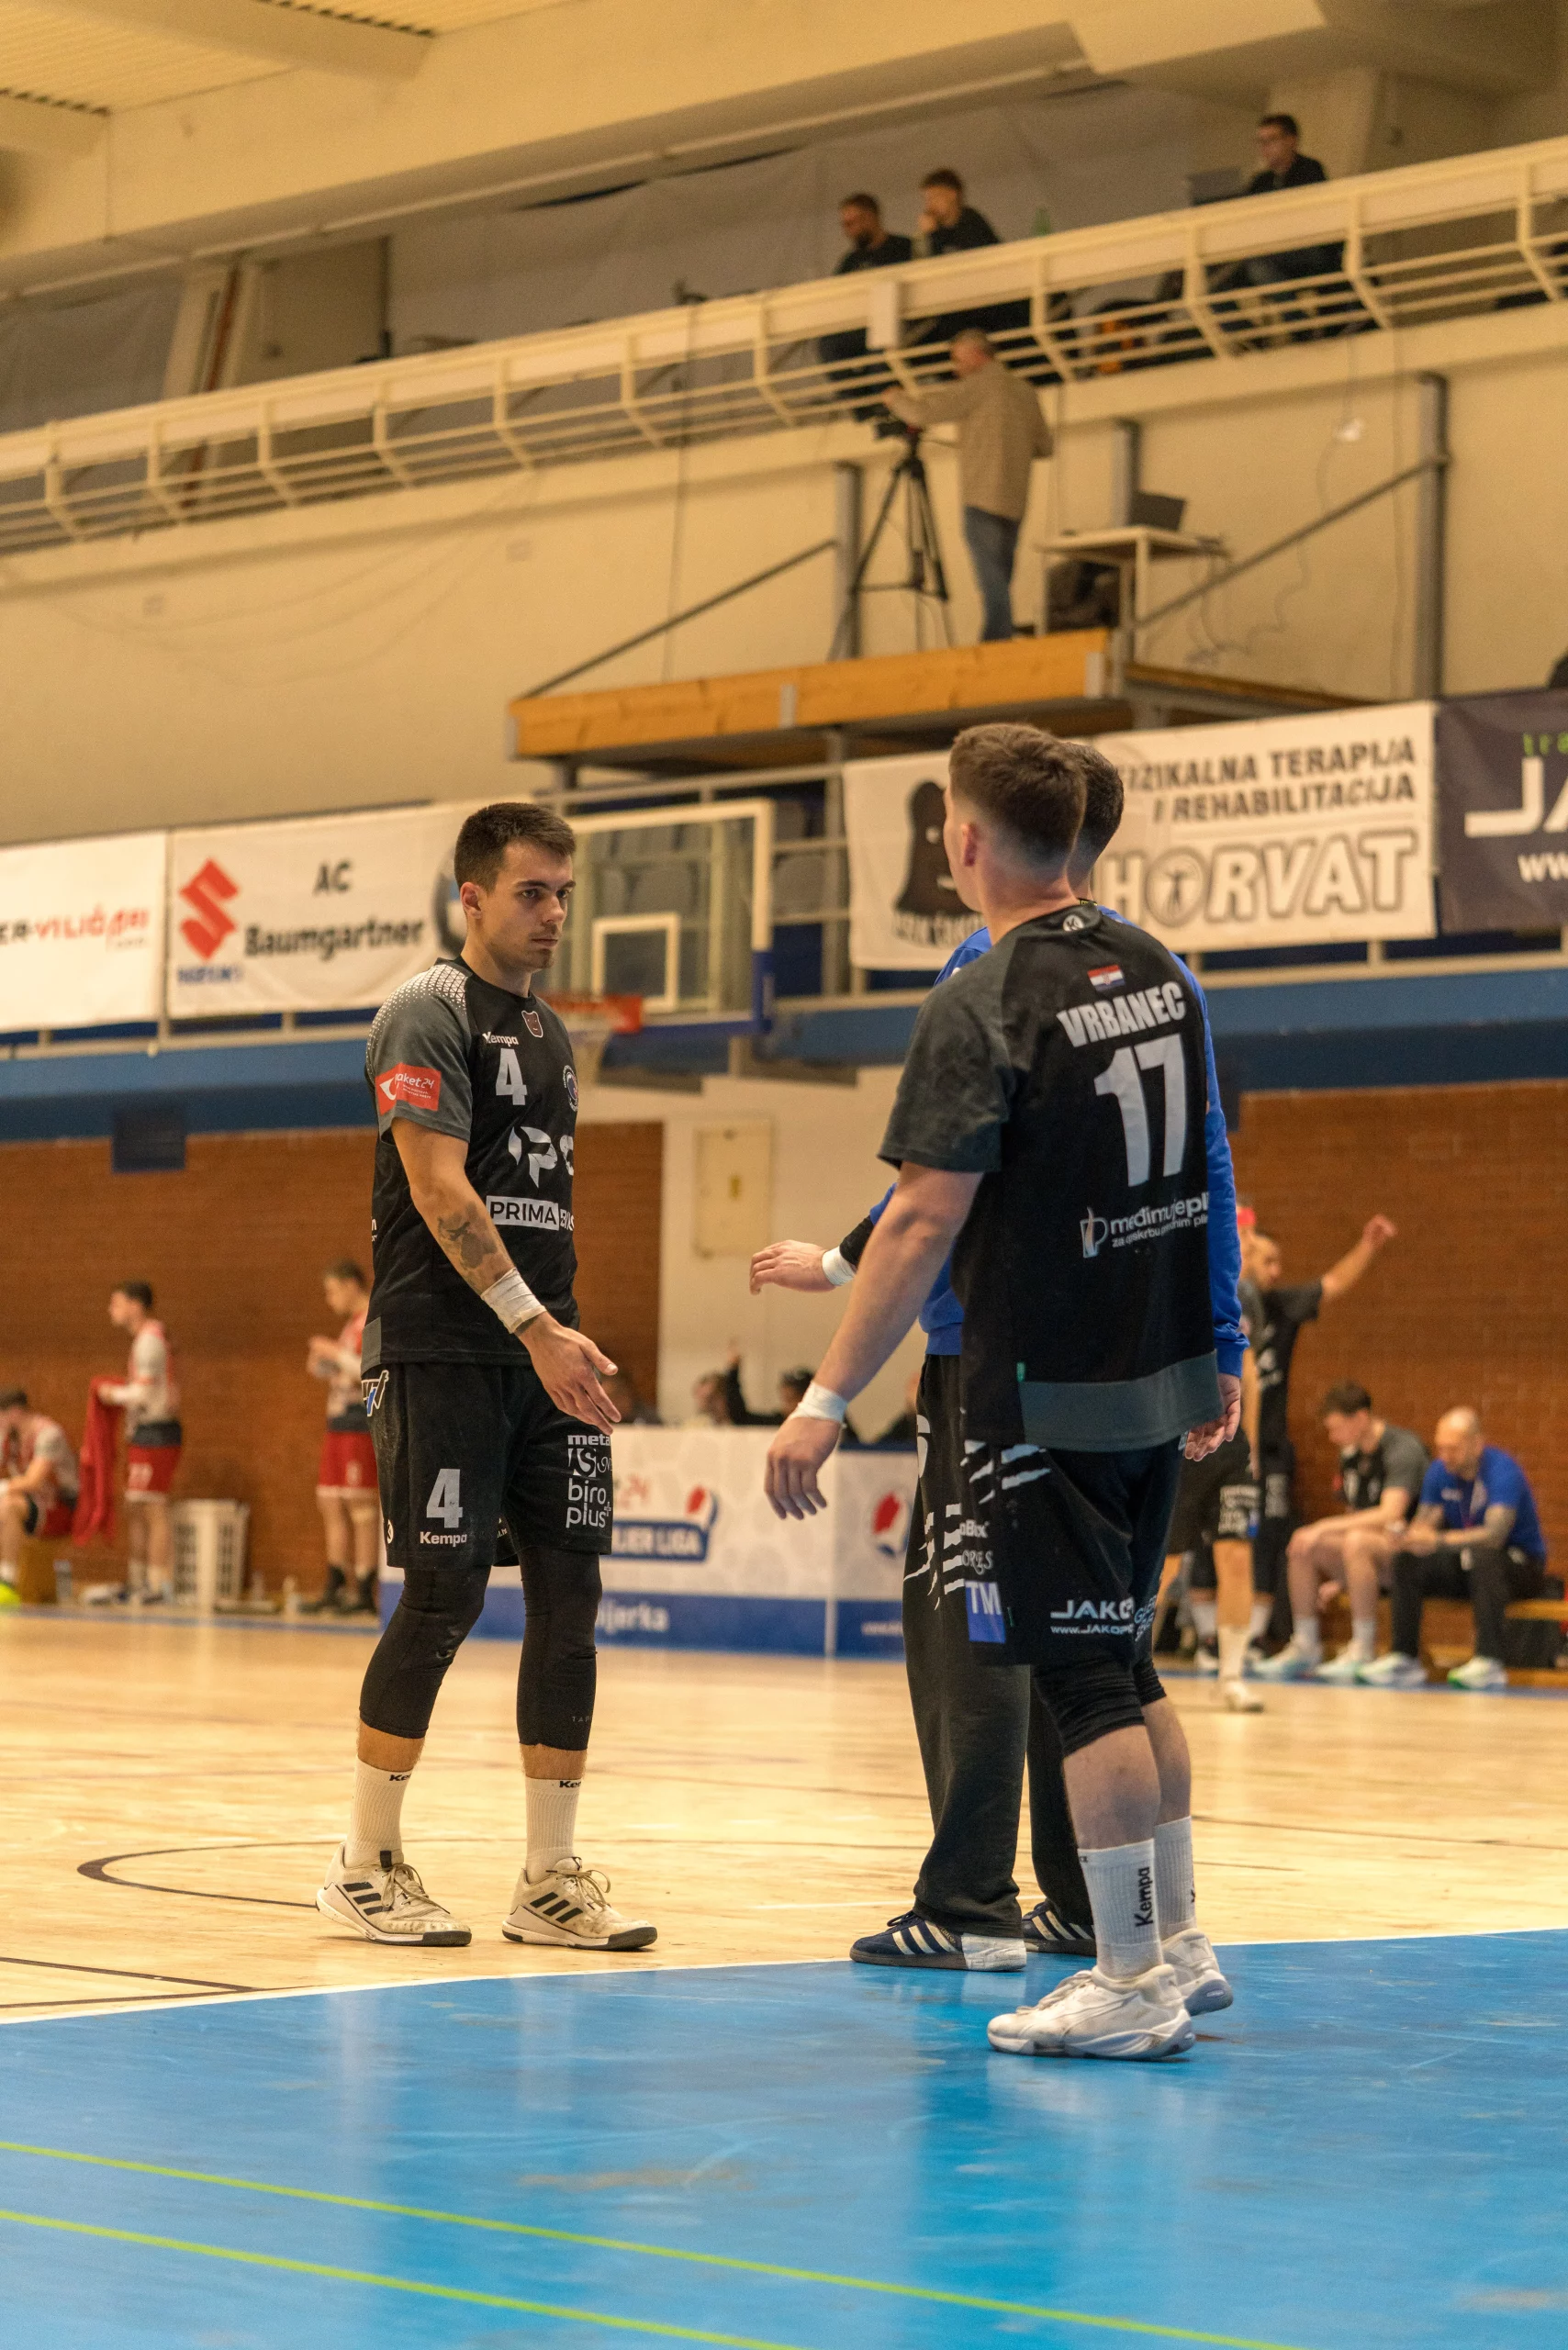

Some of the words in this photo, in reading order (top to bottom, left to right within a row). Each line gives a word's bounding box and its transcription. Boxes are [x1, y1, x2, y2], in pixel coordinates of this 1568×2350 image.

[1270, 737, 1417, 778] TERAPIJA
[1172, 775, 1415, 823] REHABILITACIJA
[313, 859, 353, 896] AC
[243, 914, 424, 963] Baumgartner
[1057, 980, 1186, 1048] VRBANEC
[482, 1031, 520, 1047] Kempa
[496, 1047, 528, 1106] 4
[1094, 1034, 1187, 1188] 17
[426, 1468, 464, 1529] 4
[567, 1477, 607, 1505] biro
[420, 1531, 467, 1548] Kempa
[1135, 1865, 1155, 1929] Kempa
